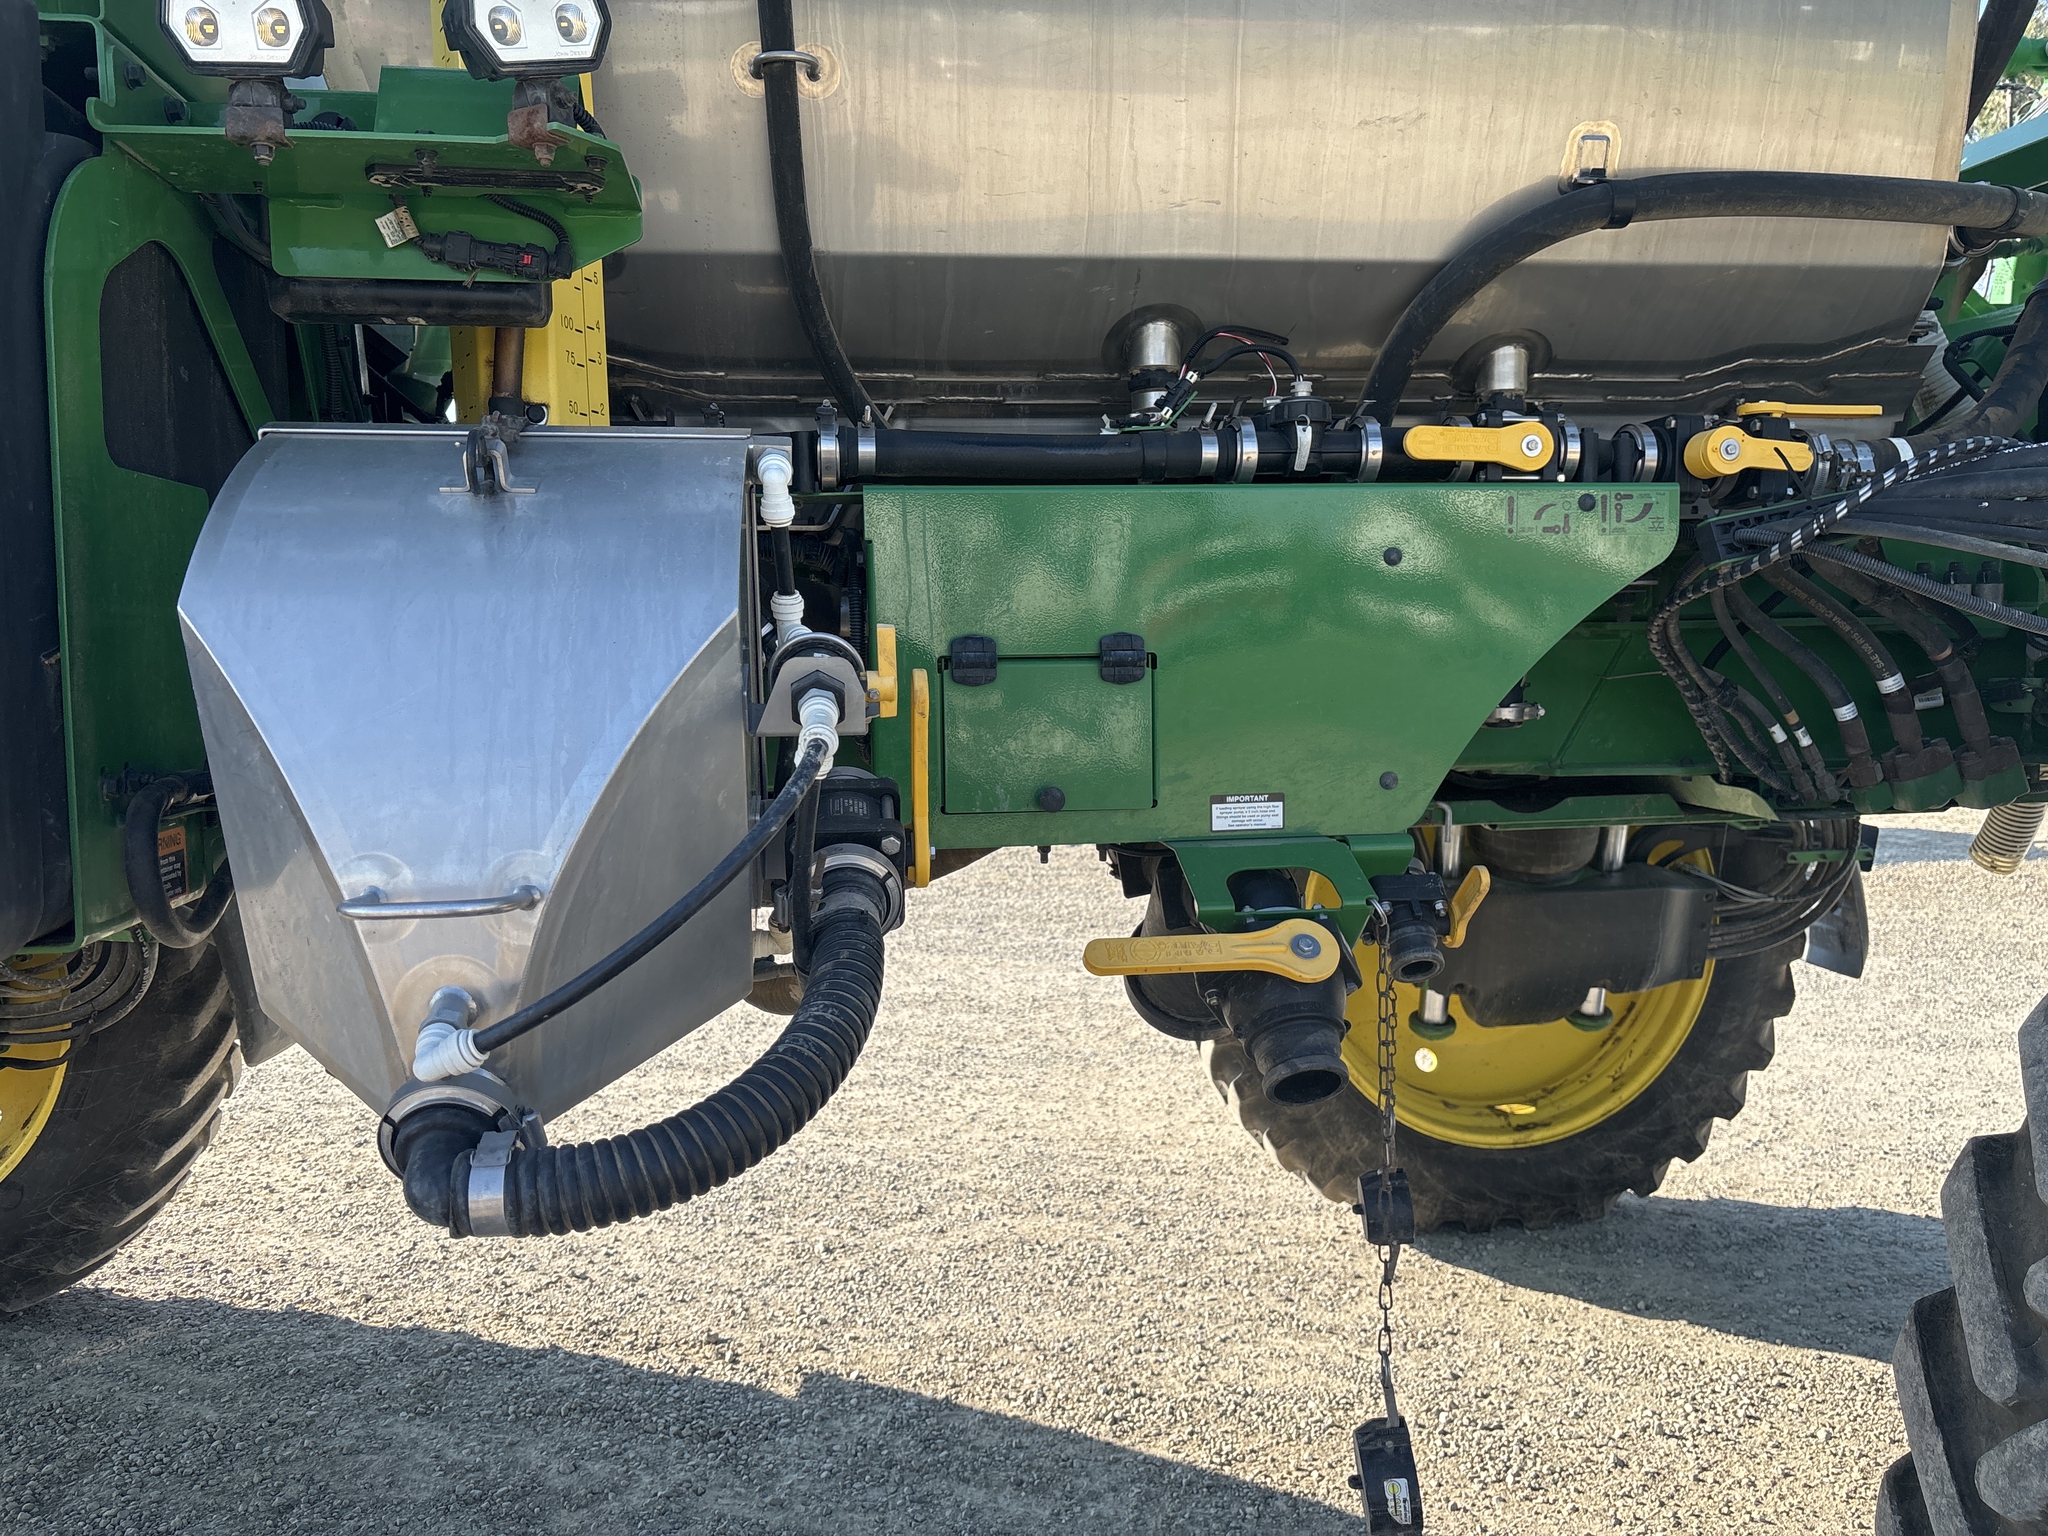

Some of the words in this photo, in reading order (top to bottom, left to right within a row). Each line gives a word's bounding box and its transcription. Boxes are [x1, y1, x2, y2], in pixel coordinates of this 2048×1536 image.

[593, 271, 599, 285] 5
[560, 314, 574, 331] 100
[596, 320, 601, 334] 4
[566, 350, 576, 365] 75
[597, 351, 602, 365] 3
[569, 400, 578, 415] 50
[600, 403, 605, 416] 2
[1832, 615, 1852, 632] MSHA
[1861, 643, 1874, 655] 100
[1870, 654, 1885, 669] SAE
